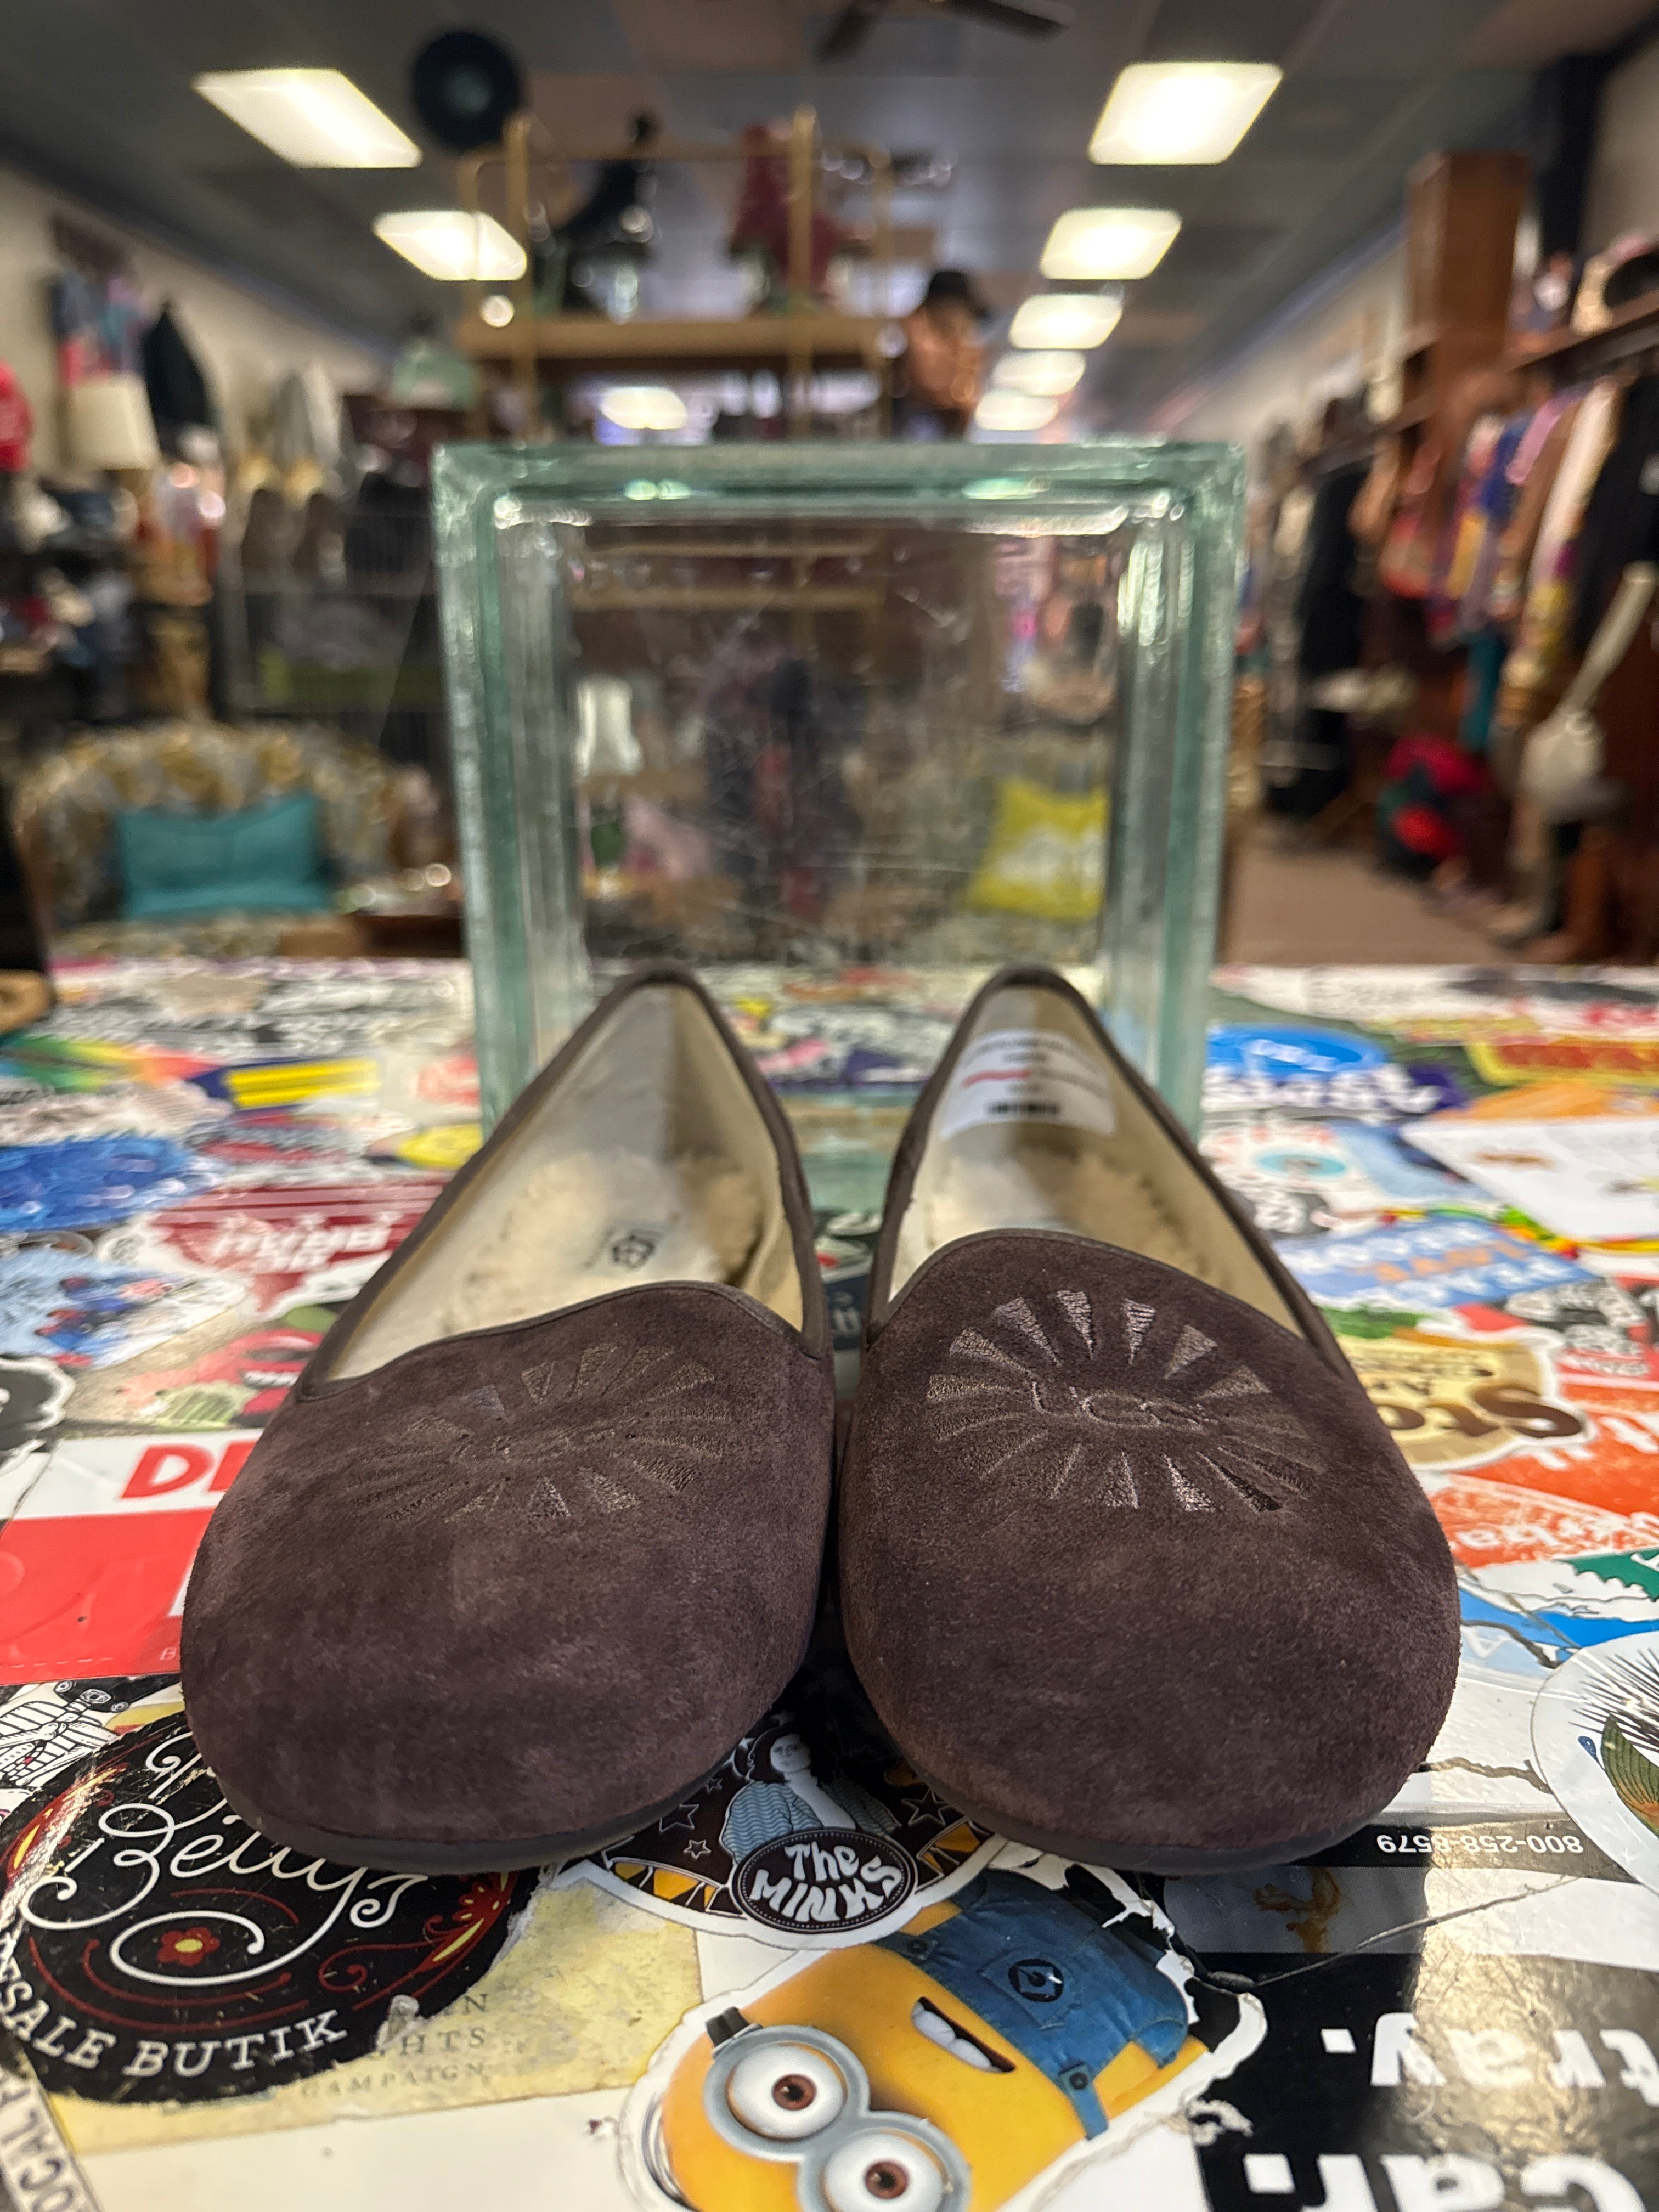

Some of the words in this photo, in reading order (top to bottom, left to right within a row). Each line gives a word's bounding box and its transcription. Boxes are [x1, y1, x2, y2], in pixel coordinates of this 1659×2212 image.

[783, 1840, 859, 1882] The
[1376, 1834, 1584, 1854] 800-258-8579
[748, 1854, 902, 1922] MINKS
[121, 2008, 349, 2078] BUTIK
